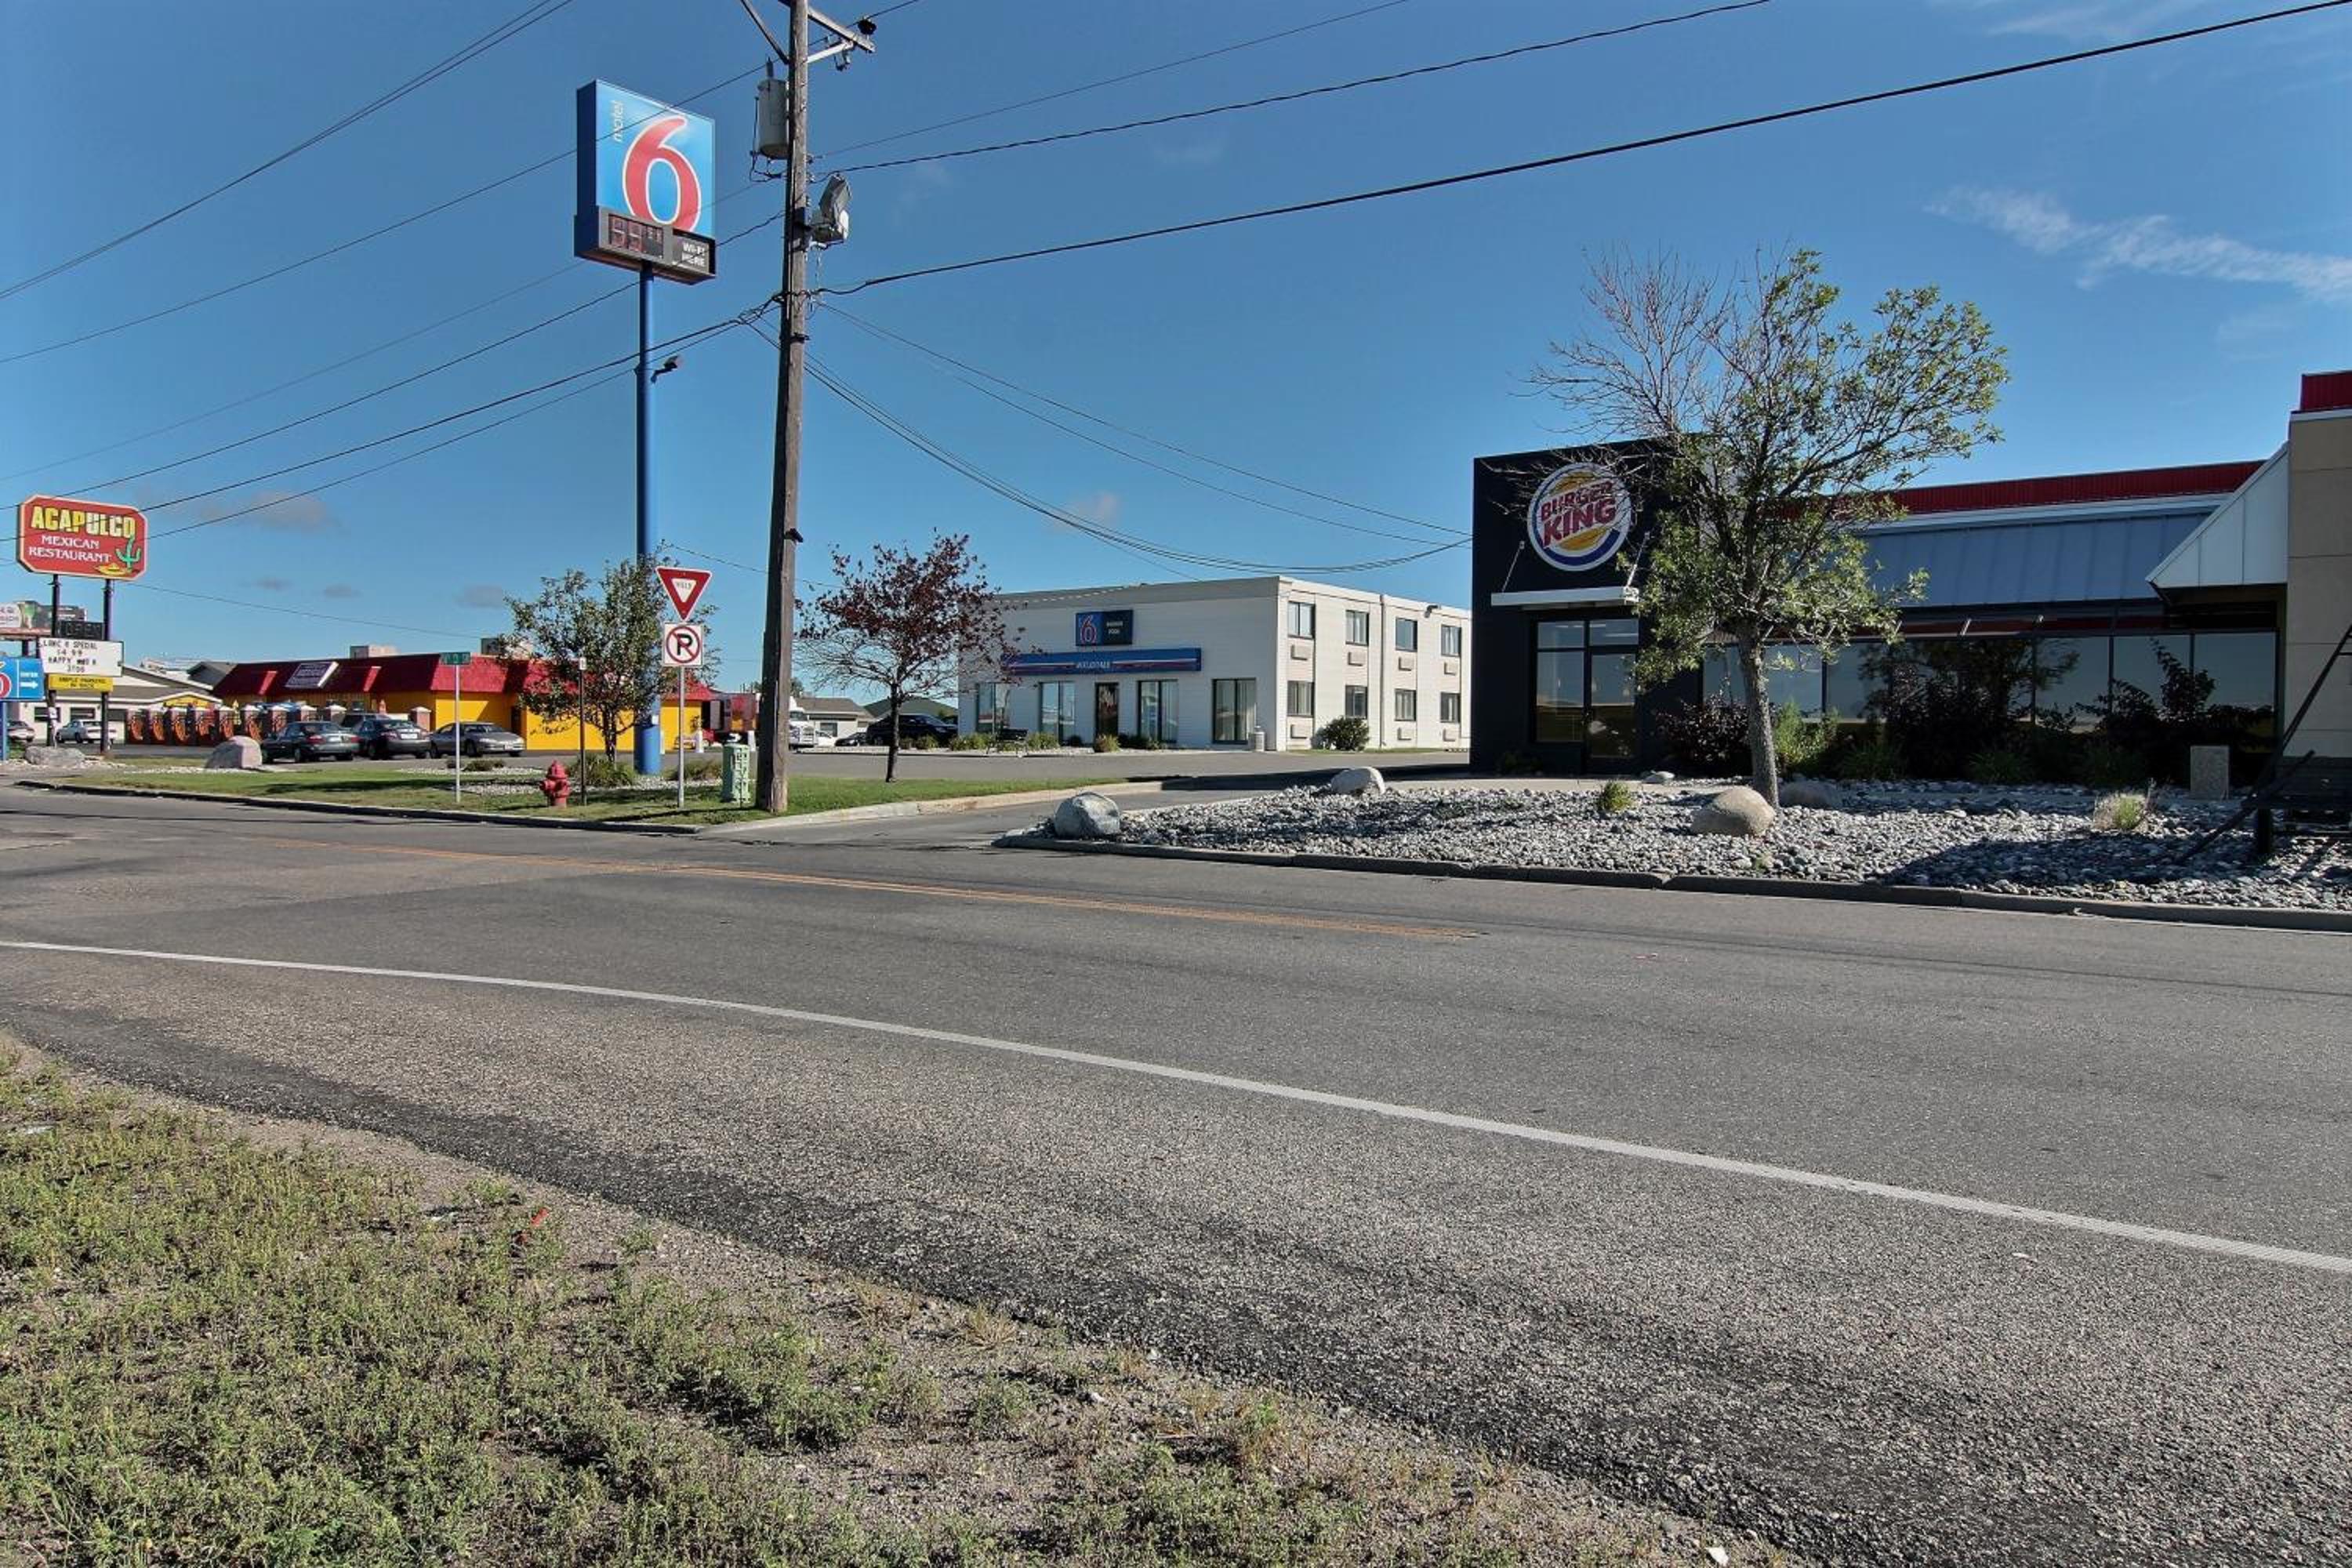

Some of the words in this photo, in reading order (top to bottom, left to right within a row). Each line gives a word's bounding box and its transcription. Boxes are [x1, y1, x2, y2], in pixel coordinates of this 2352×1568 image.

[612, 100, 624, 142] motel
[622, 115, 702, 232] 6
[31, 506, 135, 538] ACAPULCO
[1541, 480, 1613, 522] BURGER
[41, 534, 100, 550] MEXICAN
[1543, 497, 1617, 548] KING
[29, 546, 111, 563] RESTAURANT
